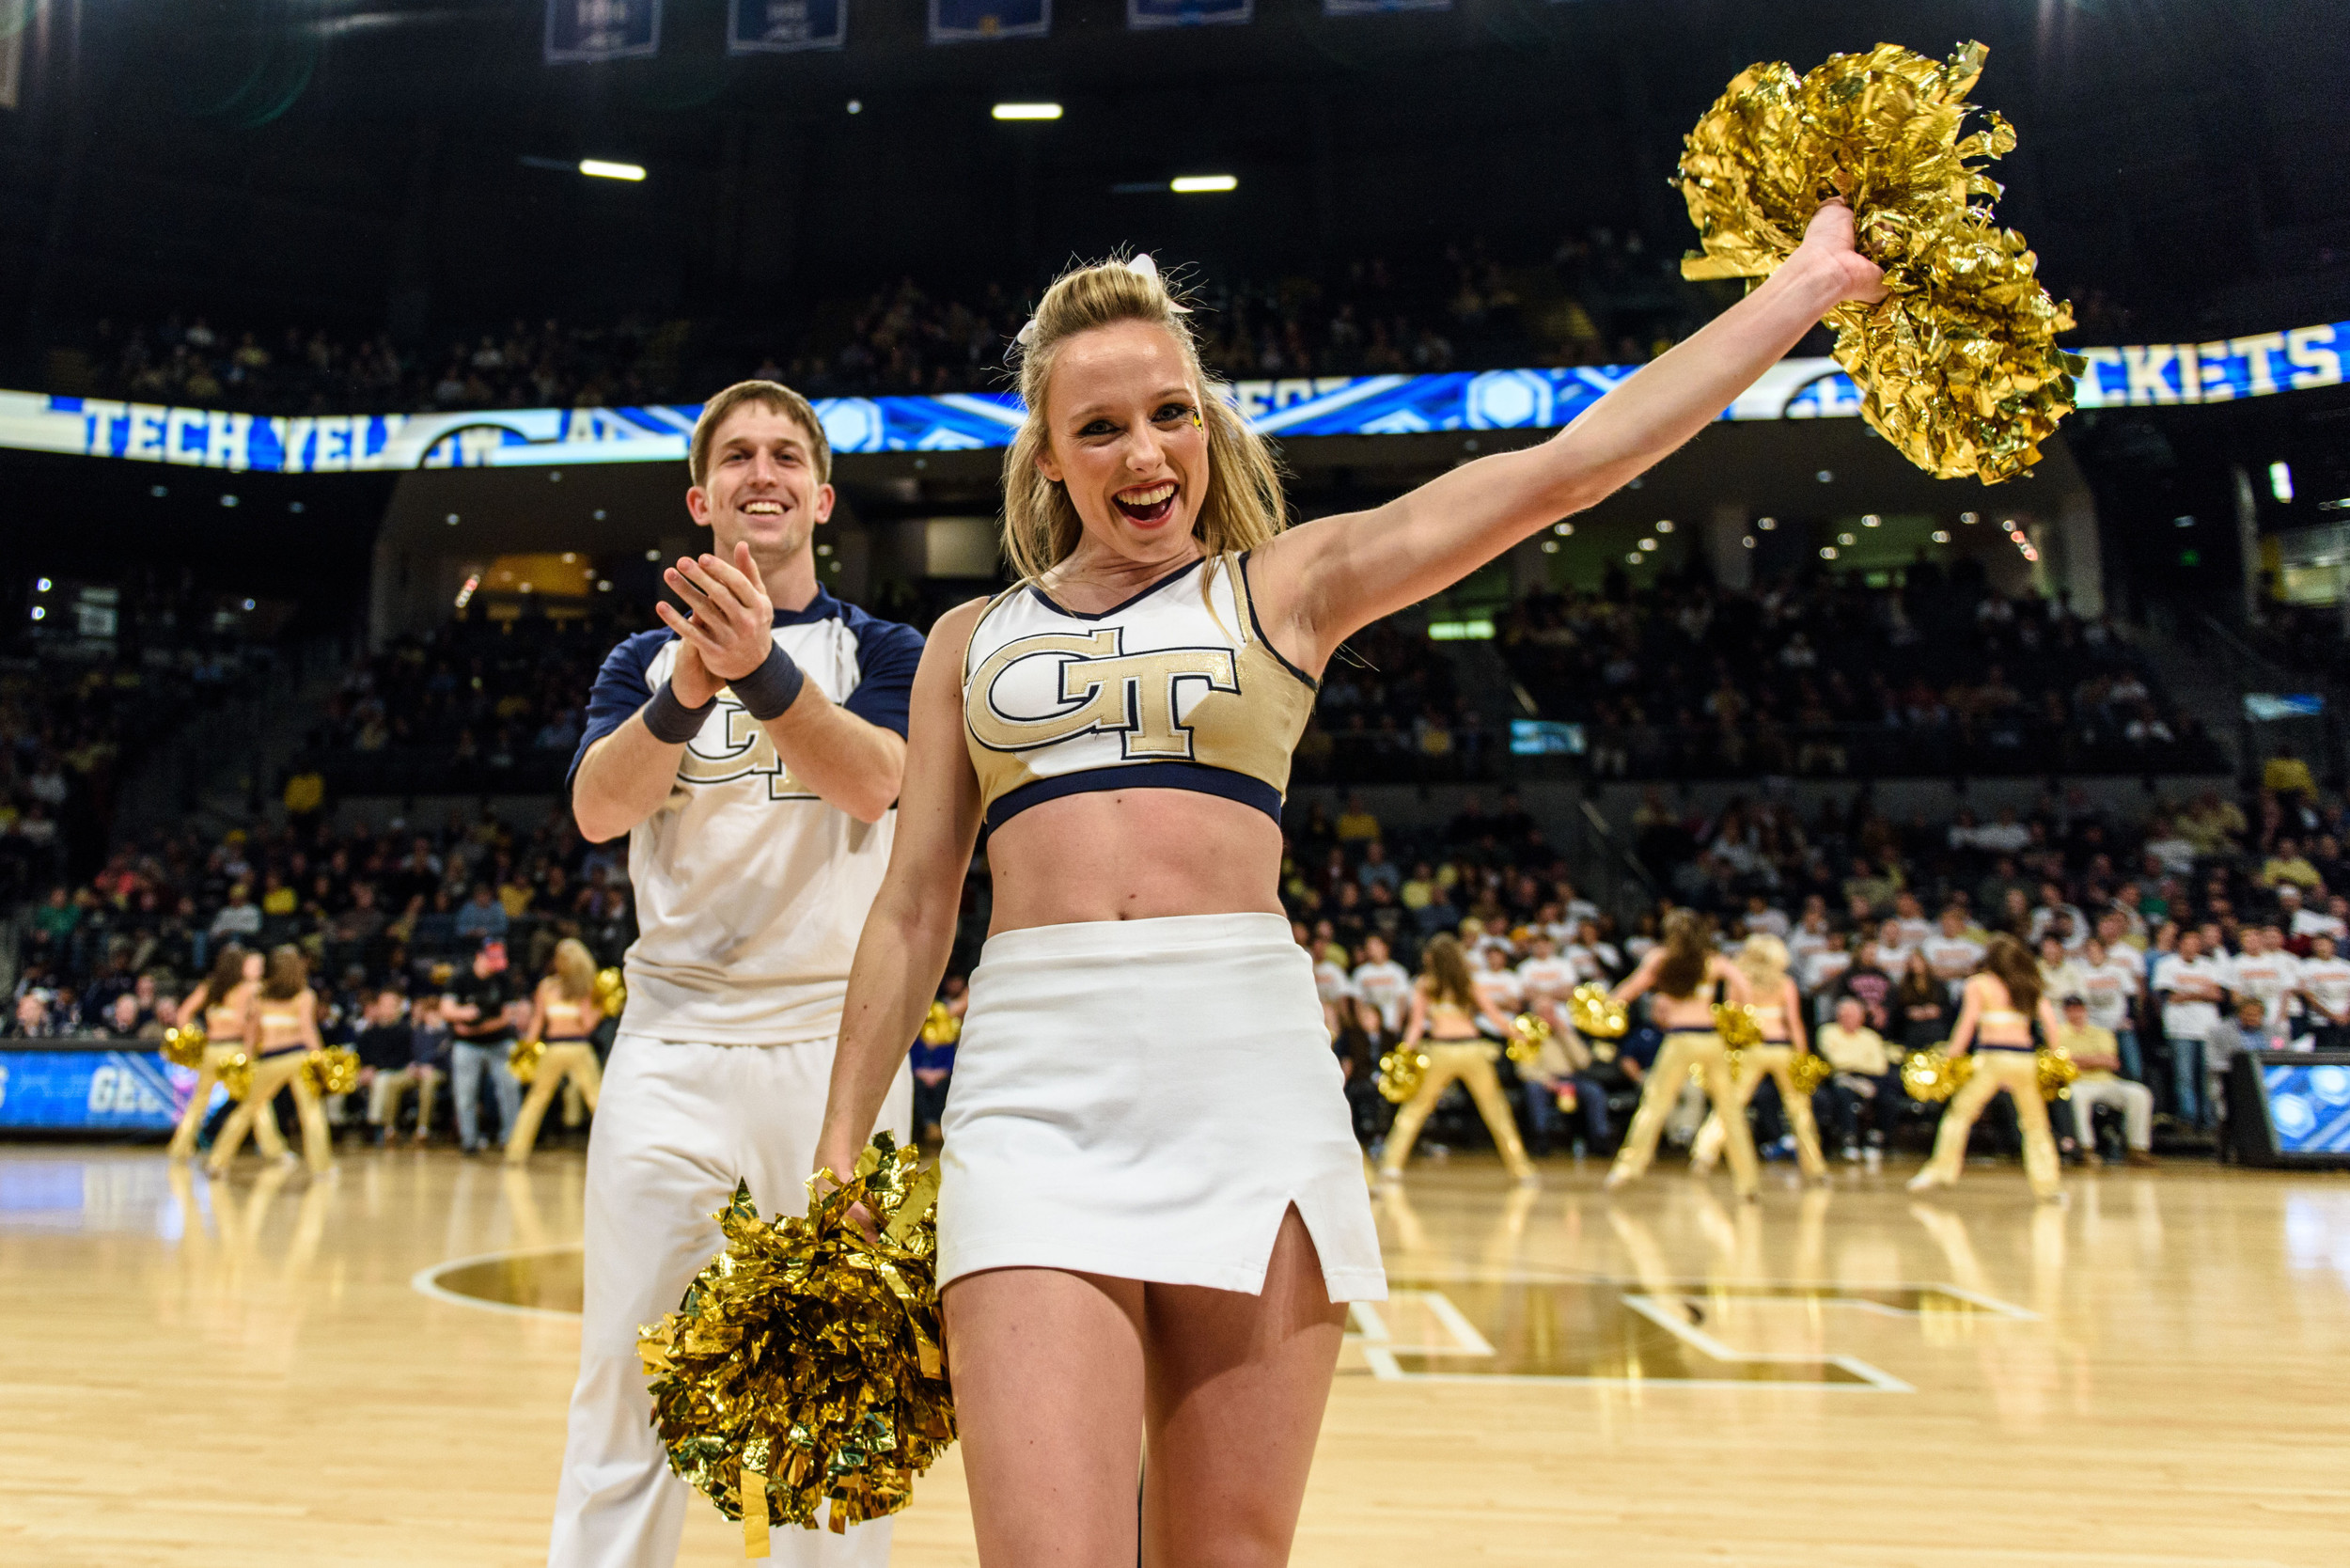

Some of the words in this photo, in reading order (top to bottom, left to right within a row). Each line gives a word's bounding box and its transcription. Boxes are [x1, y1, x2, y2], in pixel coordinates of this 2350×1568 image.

[2074, 323, 2342, 408] CKETS
[82, 397, 254, 472] TECH
[677, 685, 822, 801] G
[965, 626, 1242, 761] GT
